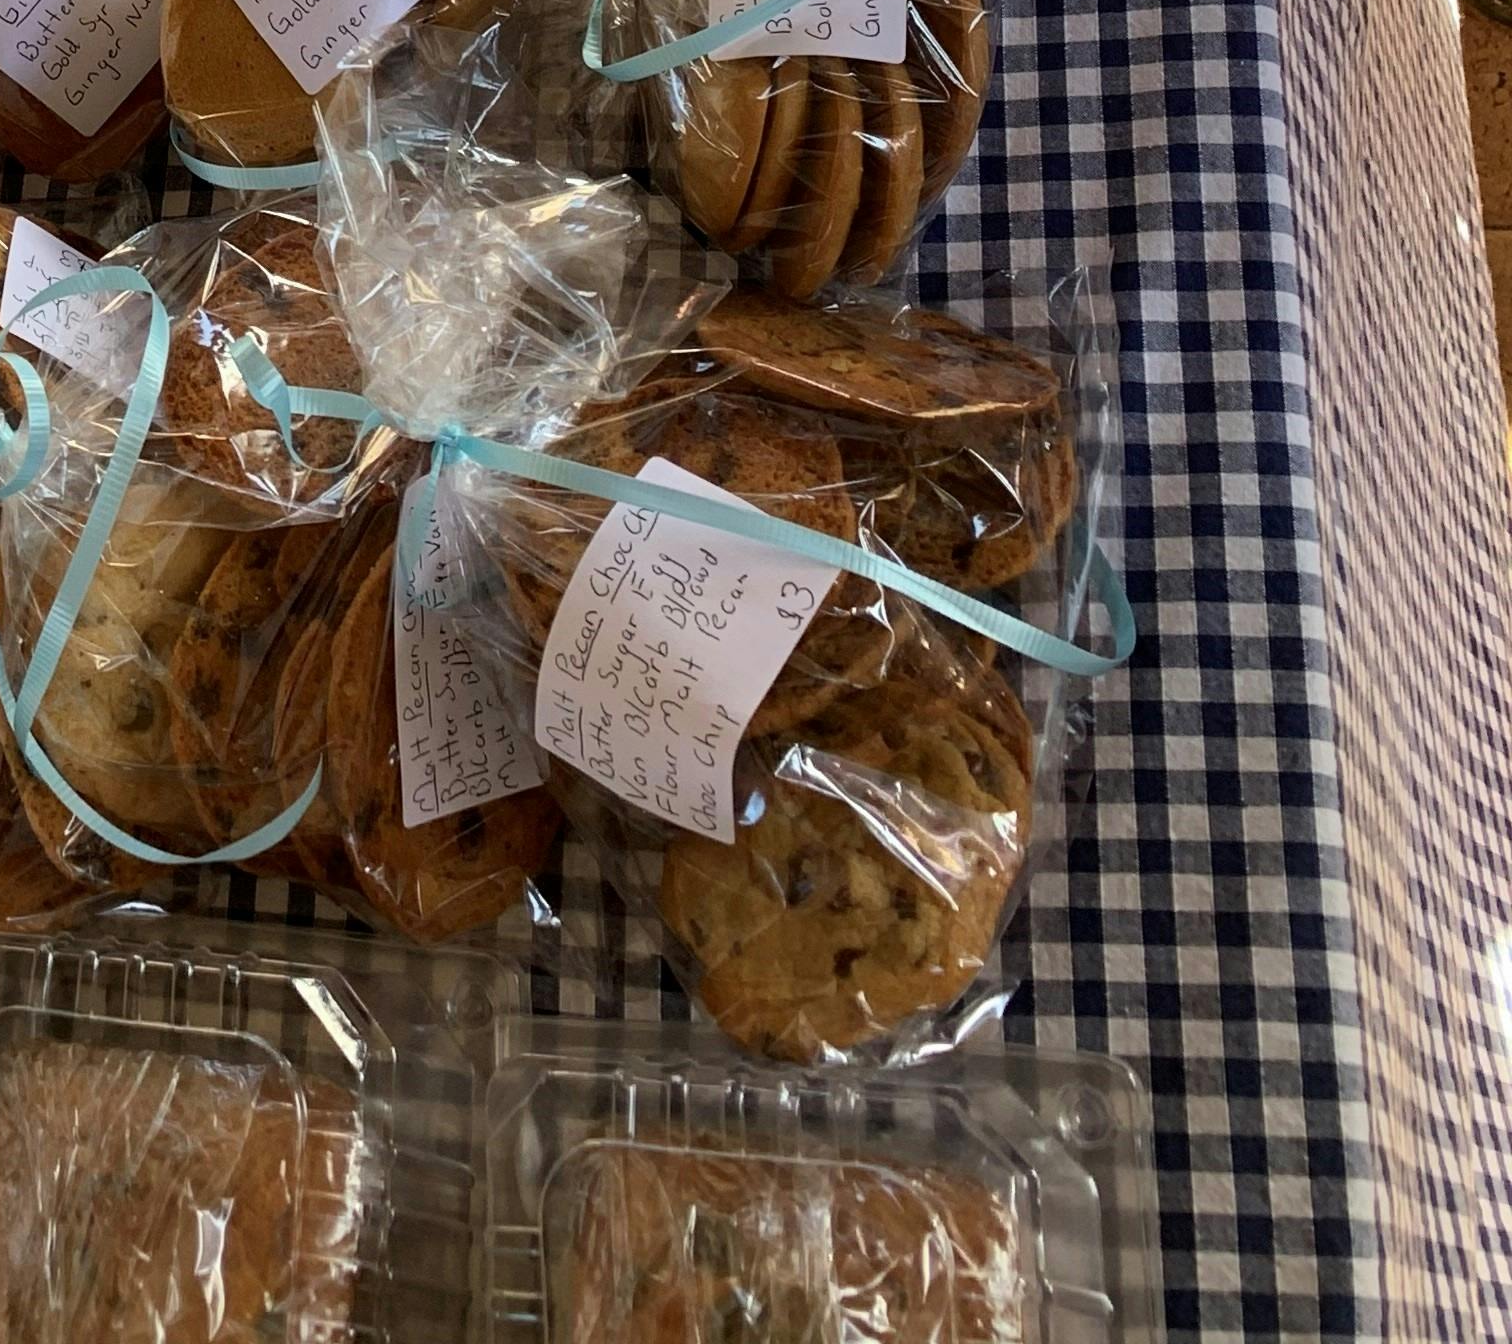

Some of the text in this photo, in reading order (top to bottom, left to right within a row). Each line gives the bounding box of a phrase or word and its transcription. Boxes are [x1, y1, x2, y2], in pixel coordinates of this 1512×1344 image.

[41, 40, 81, 82] Gold
[65, 38, 125, 108] Ginger
[300, 5, 370, 71] Ginger
[589, 541, 633, 598] Choc
[402, 643, 421, 721] Pecan
[554, 609, 600, 682] Pecan
[598, 617, 650, 690] Sugar
[545, 689, 583, 761] Malt
[656, 573, 750, 817] Flour Malt Pecan
[442, 715, 467, 803] Butter
[589, 701, 616, 779] Butter
[691, 704, 743, 831] Choc Chip
